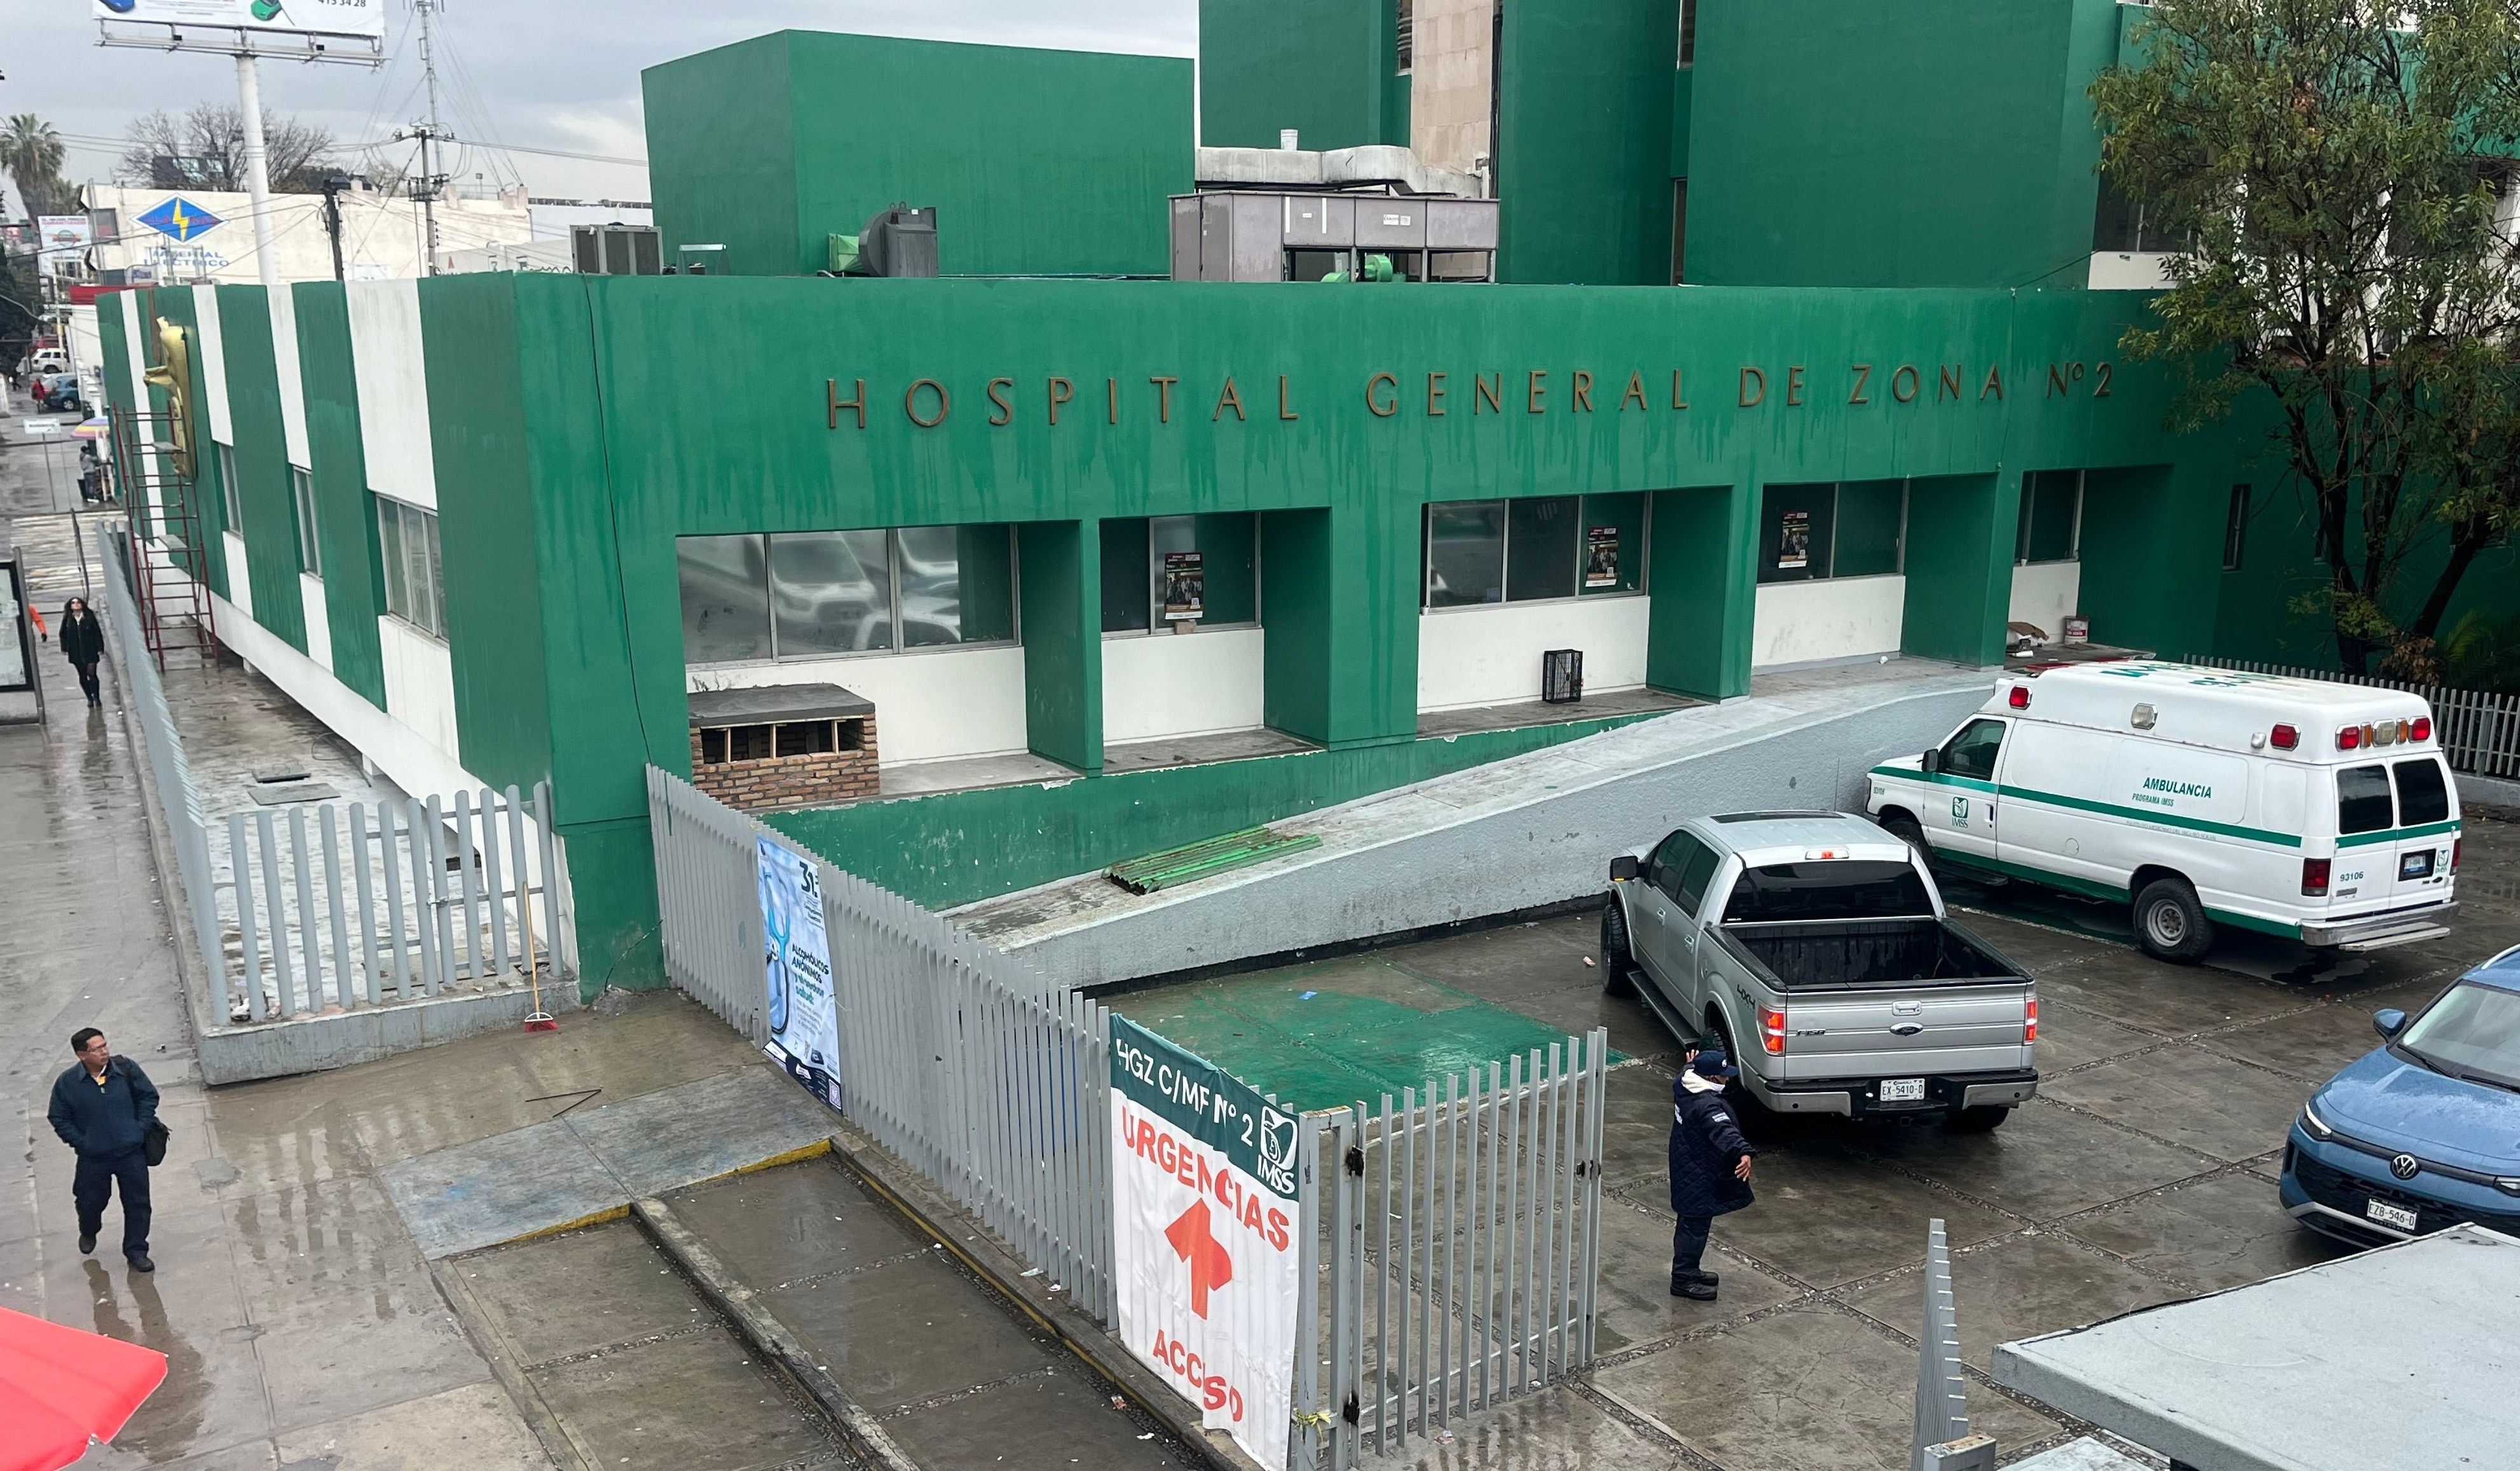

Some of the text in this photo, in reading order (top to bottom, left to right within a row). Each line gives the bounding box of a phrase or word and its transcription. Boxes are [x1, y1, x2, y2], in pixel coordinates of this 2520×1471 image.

[826, 376, 1298, 428] HOSPITAL
[1366, 368, 1688, 417] GENERAL
[1739, 366, 1804, 407] DE
[1848, 364, 2003, 405] ZONA
[2093, 362, 2111, 397] 2
[2132, 793, 2160, 804] PROGRAMA
[2143, 777, 2212, 798] AMBULANCIA
[1952, 818, 1968, 828] IMSS
[2340, 871, 2364, 882] 93106
[1116, 1038, 1154, 1086] HGZ
[1158, 1064, 1210, 1114] C/MF
[1241, 1113, 1253, 1147] 2
[1122, 1105, 1290, 1252] URGENCIAS
[1257, 1154, 1296, 1194] IMSS
[1153, 1329, 1243, 1422] ACCSO
